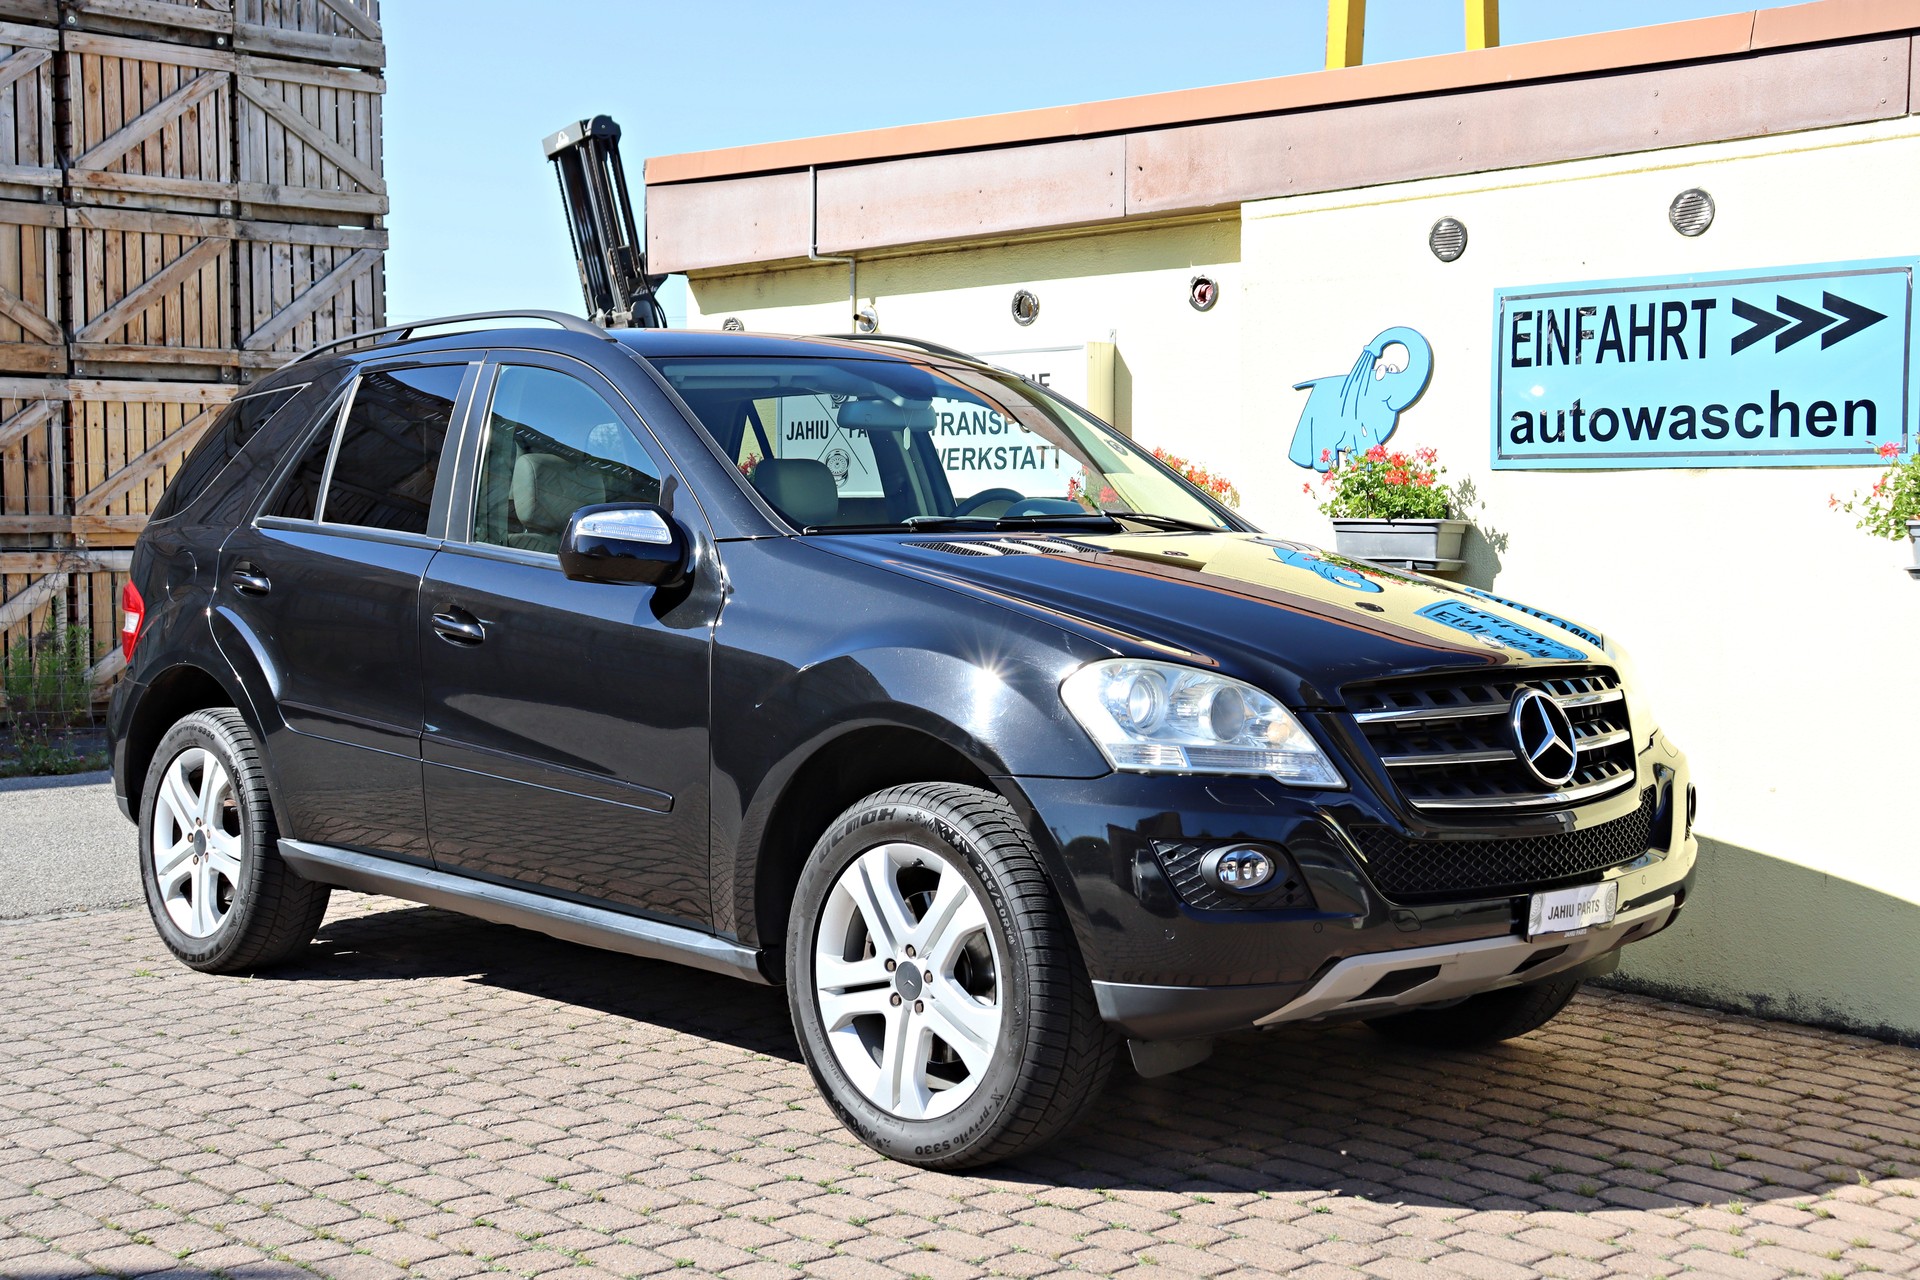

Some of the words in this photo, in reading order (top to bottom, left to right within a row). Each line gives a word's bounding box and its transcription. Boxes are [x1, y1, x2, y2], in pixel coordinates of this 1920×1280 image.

[1511, 298, 1717, 368] EINFAHRT
[1509, 389, 1877, 444] autowaschen
[786, 420, 829, 441] JAHIU
[1548, 903, 1575, 920] JAHIU
[1576, 899, 1600, 916] PARTS
[914, 1140, 951, 1156] S330
